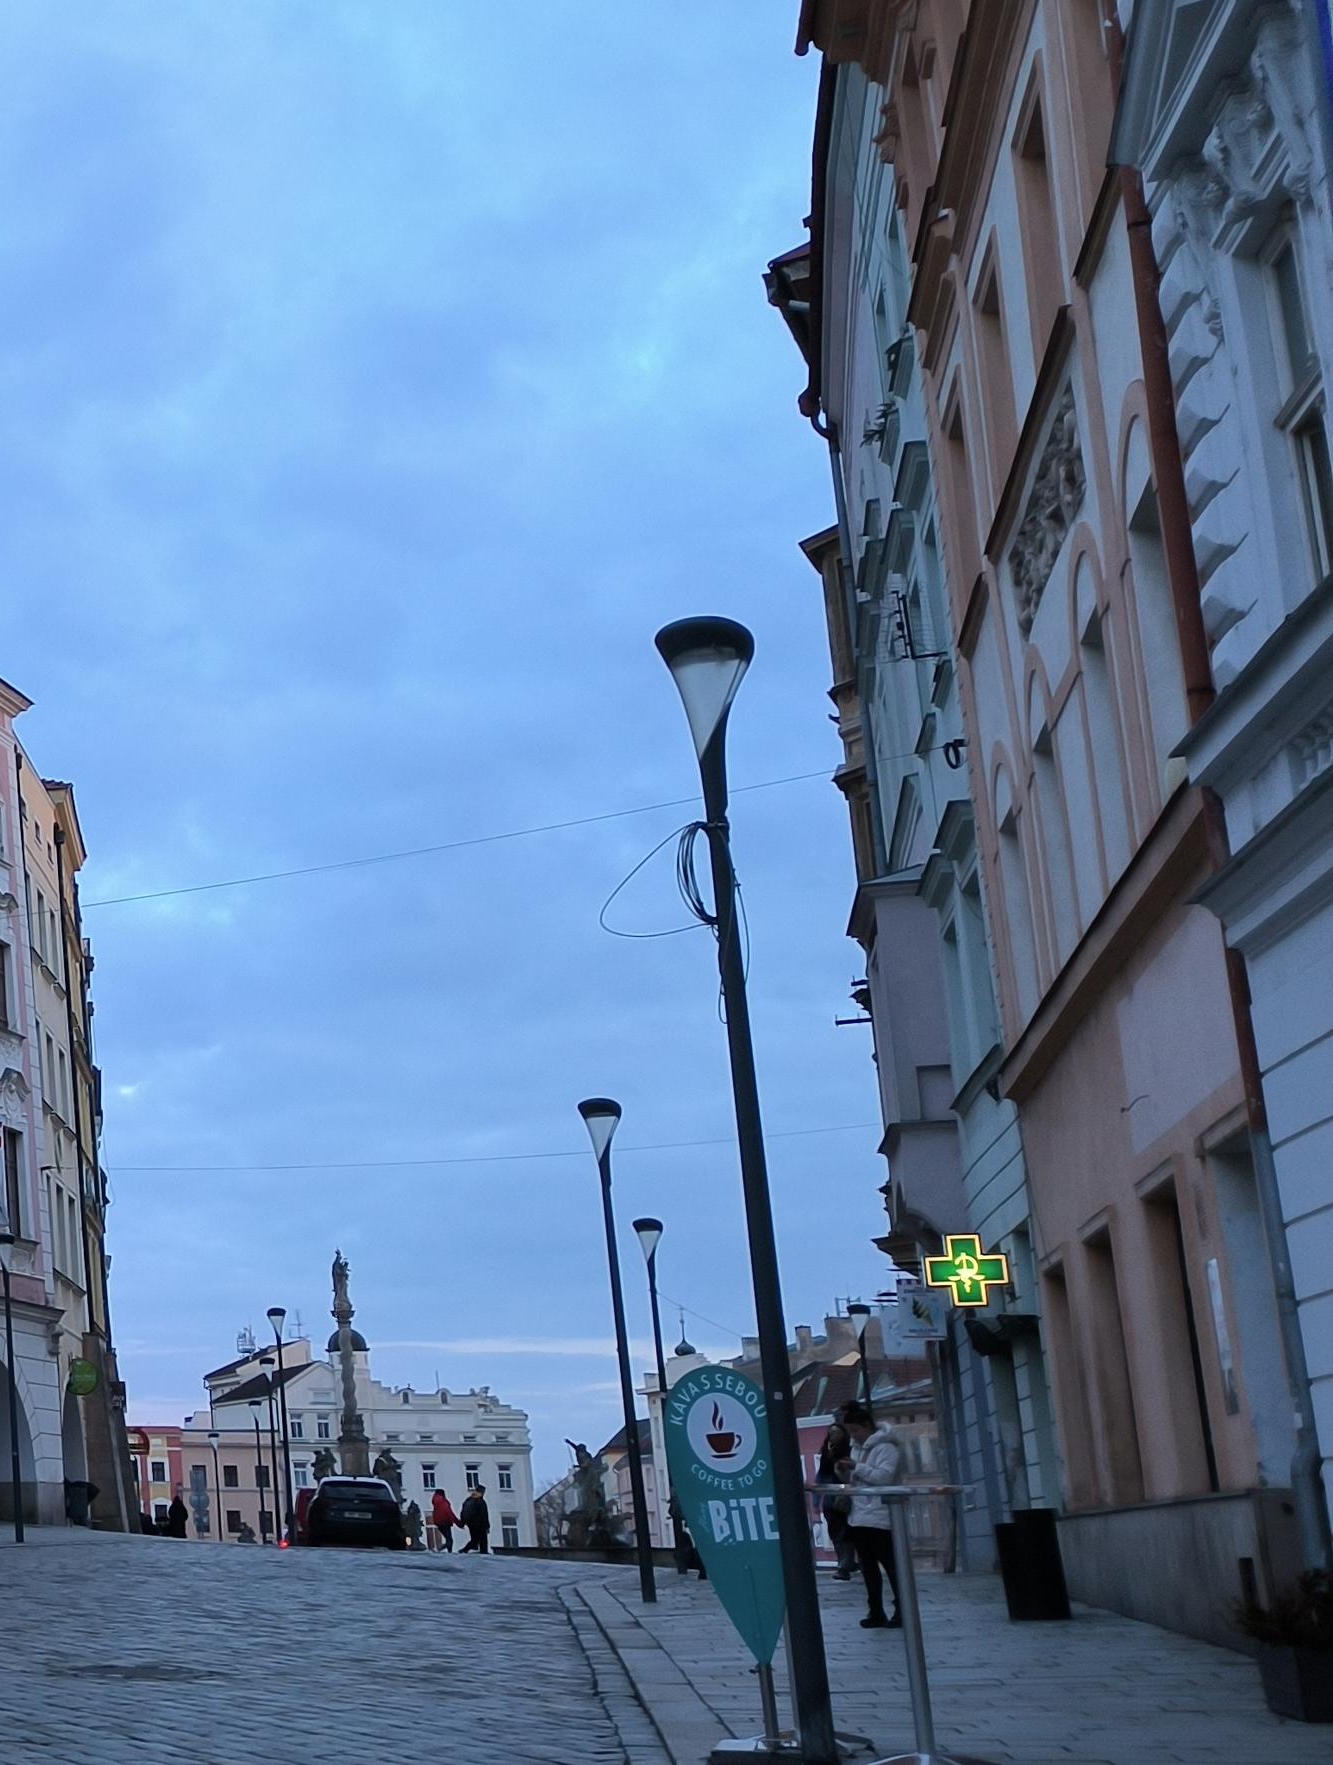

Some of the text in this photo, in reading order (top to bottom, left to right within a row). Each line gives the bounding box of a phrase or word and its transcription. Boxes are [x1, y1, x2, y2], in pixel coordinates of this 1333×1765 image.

[700, 1374, 711, 1390] S
[715, 1373, 767, 1418] SEBOU
[691, 1459, 767, 1491] COFFEE TO GO
